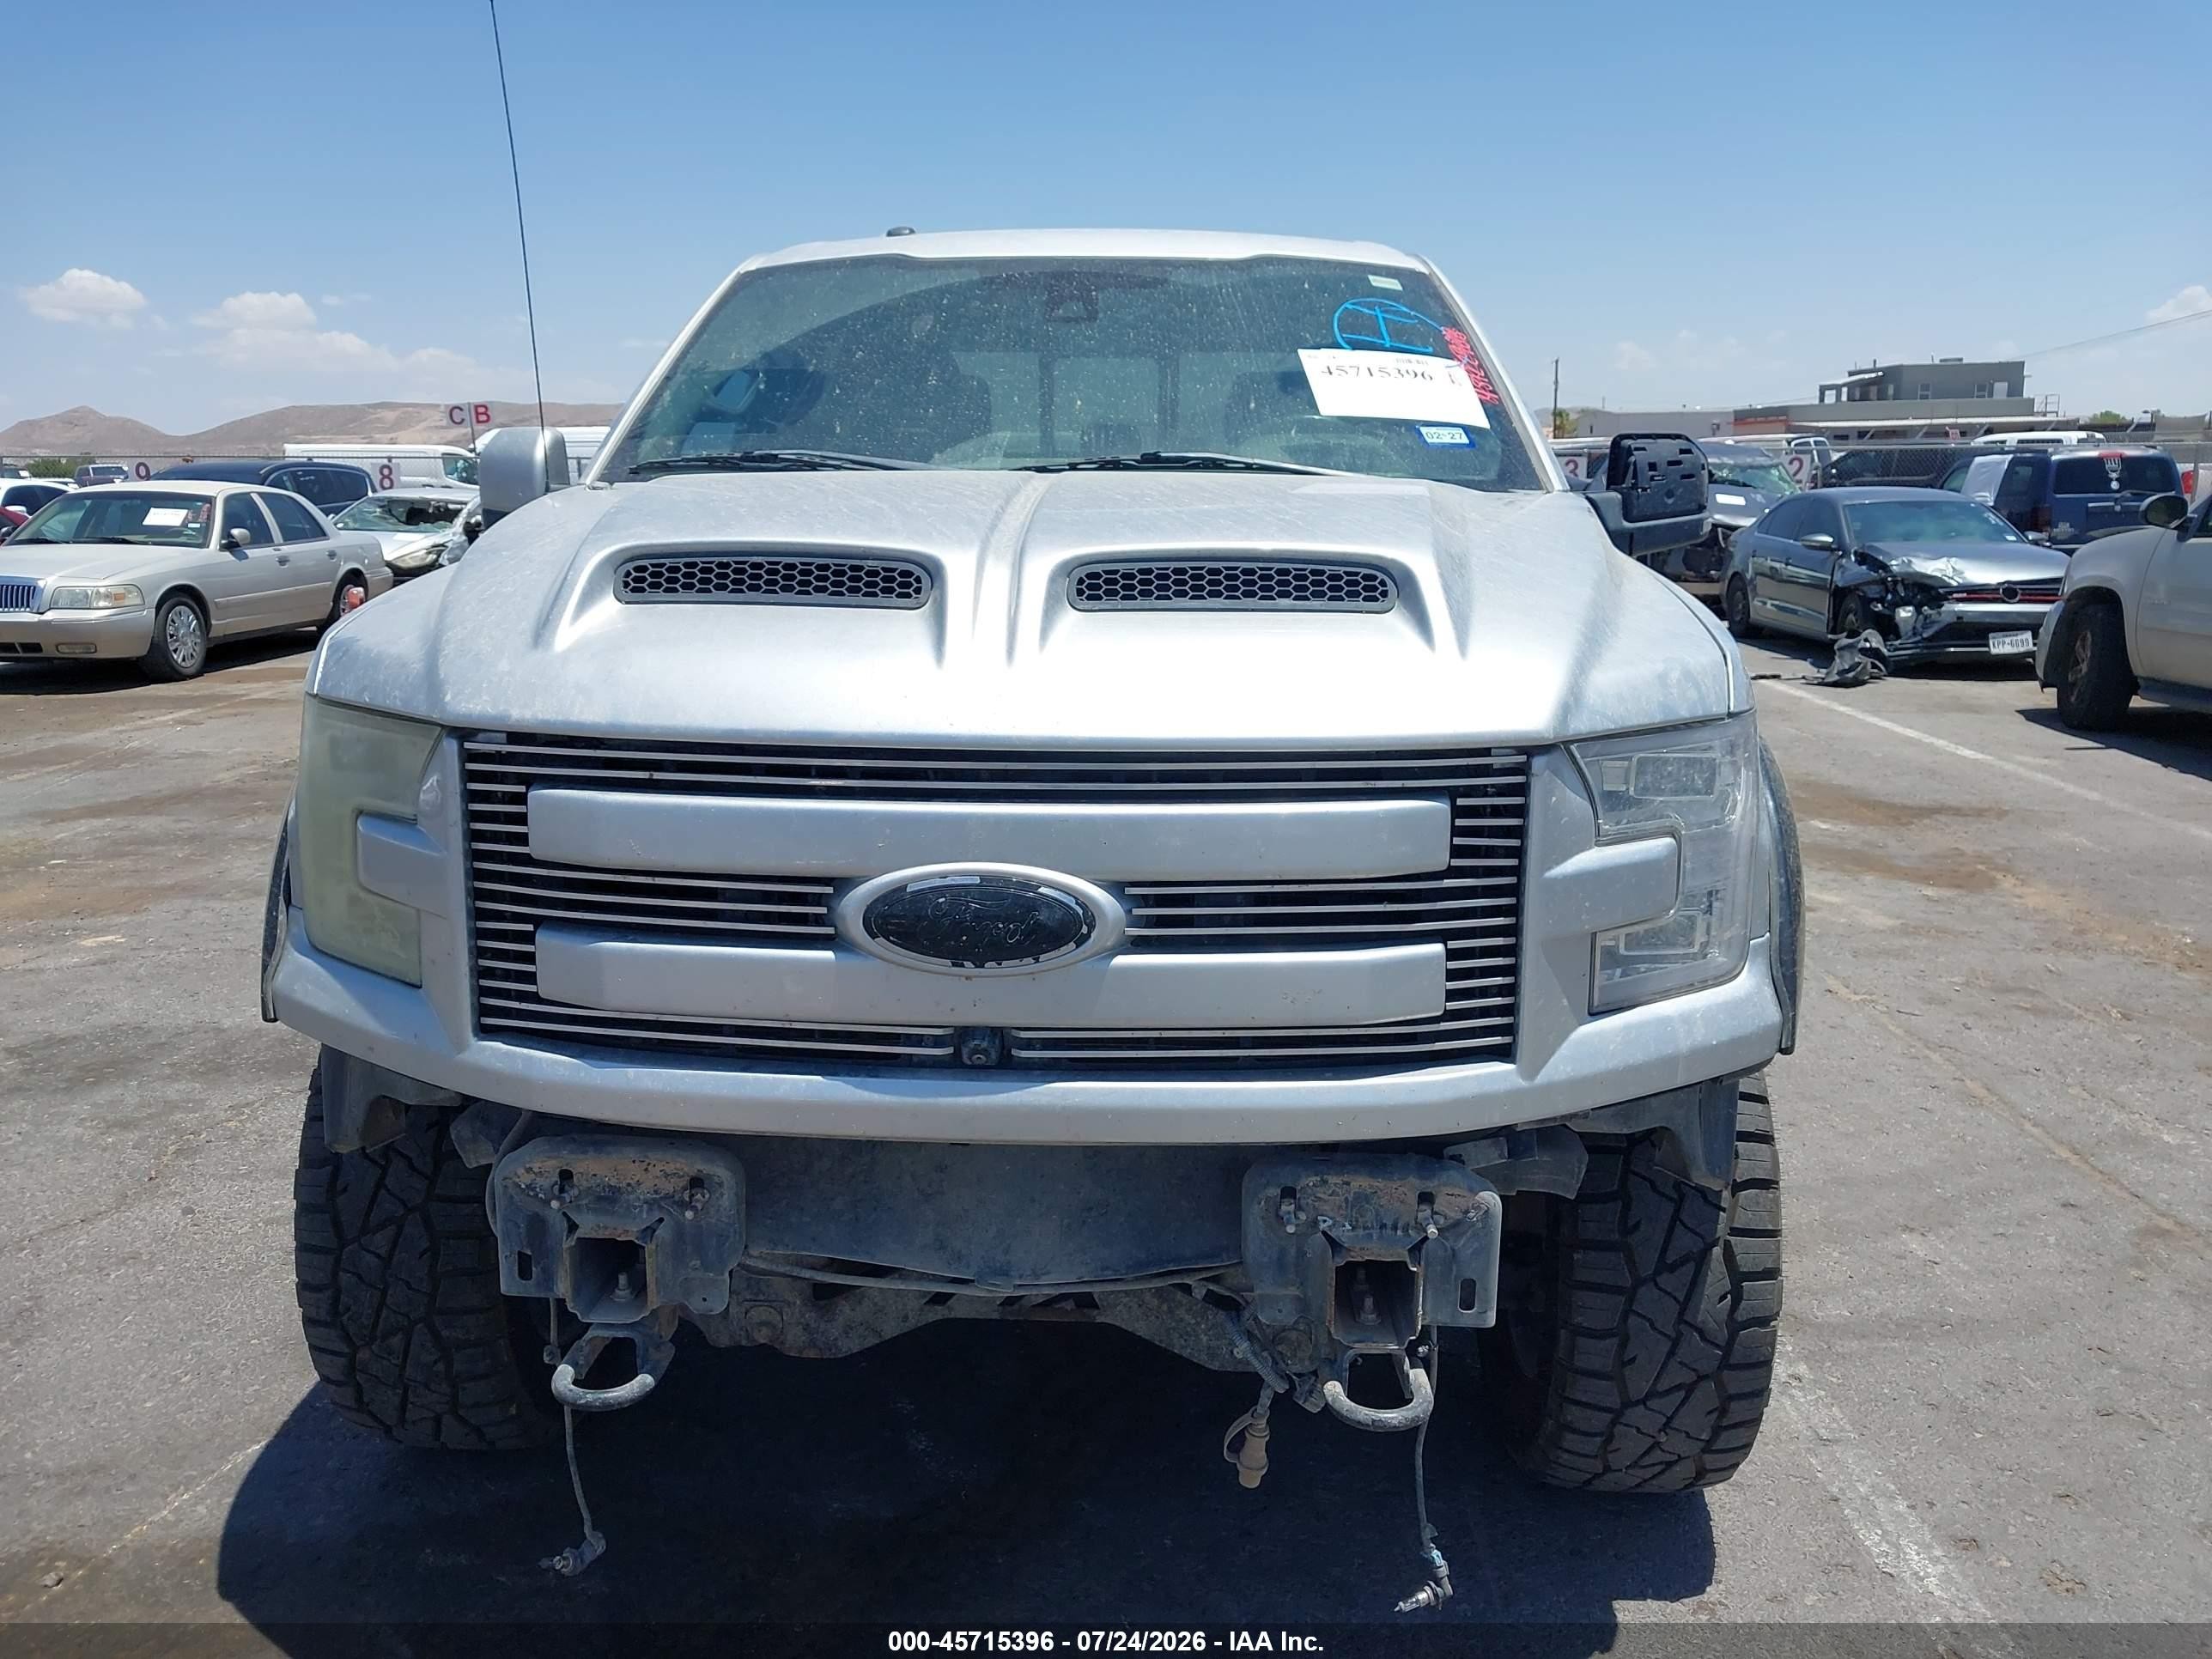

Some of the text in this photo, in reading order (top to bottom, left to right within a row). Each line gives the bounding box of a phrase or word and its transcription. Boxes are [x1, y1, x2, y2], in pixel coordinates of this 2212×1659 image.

[1321, 364, 1434, 382] 45715396
[449, 405, 465, 425] C
[474, 404, 491, 423] B
[379, 464, 394, 490] 8
[1788, 456, 1804, 483] 2
[916, 896, 1041, 945] Ford
